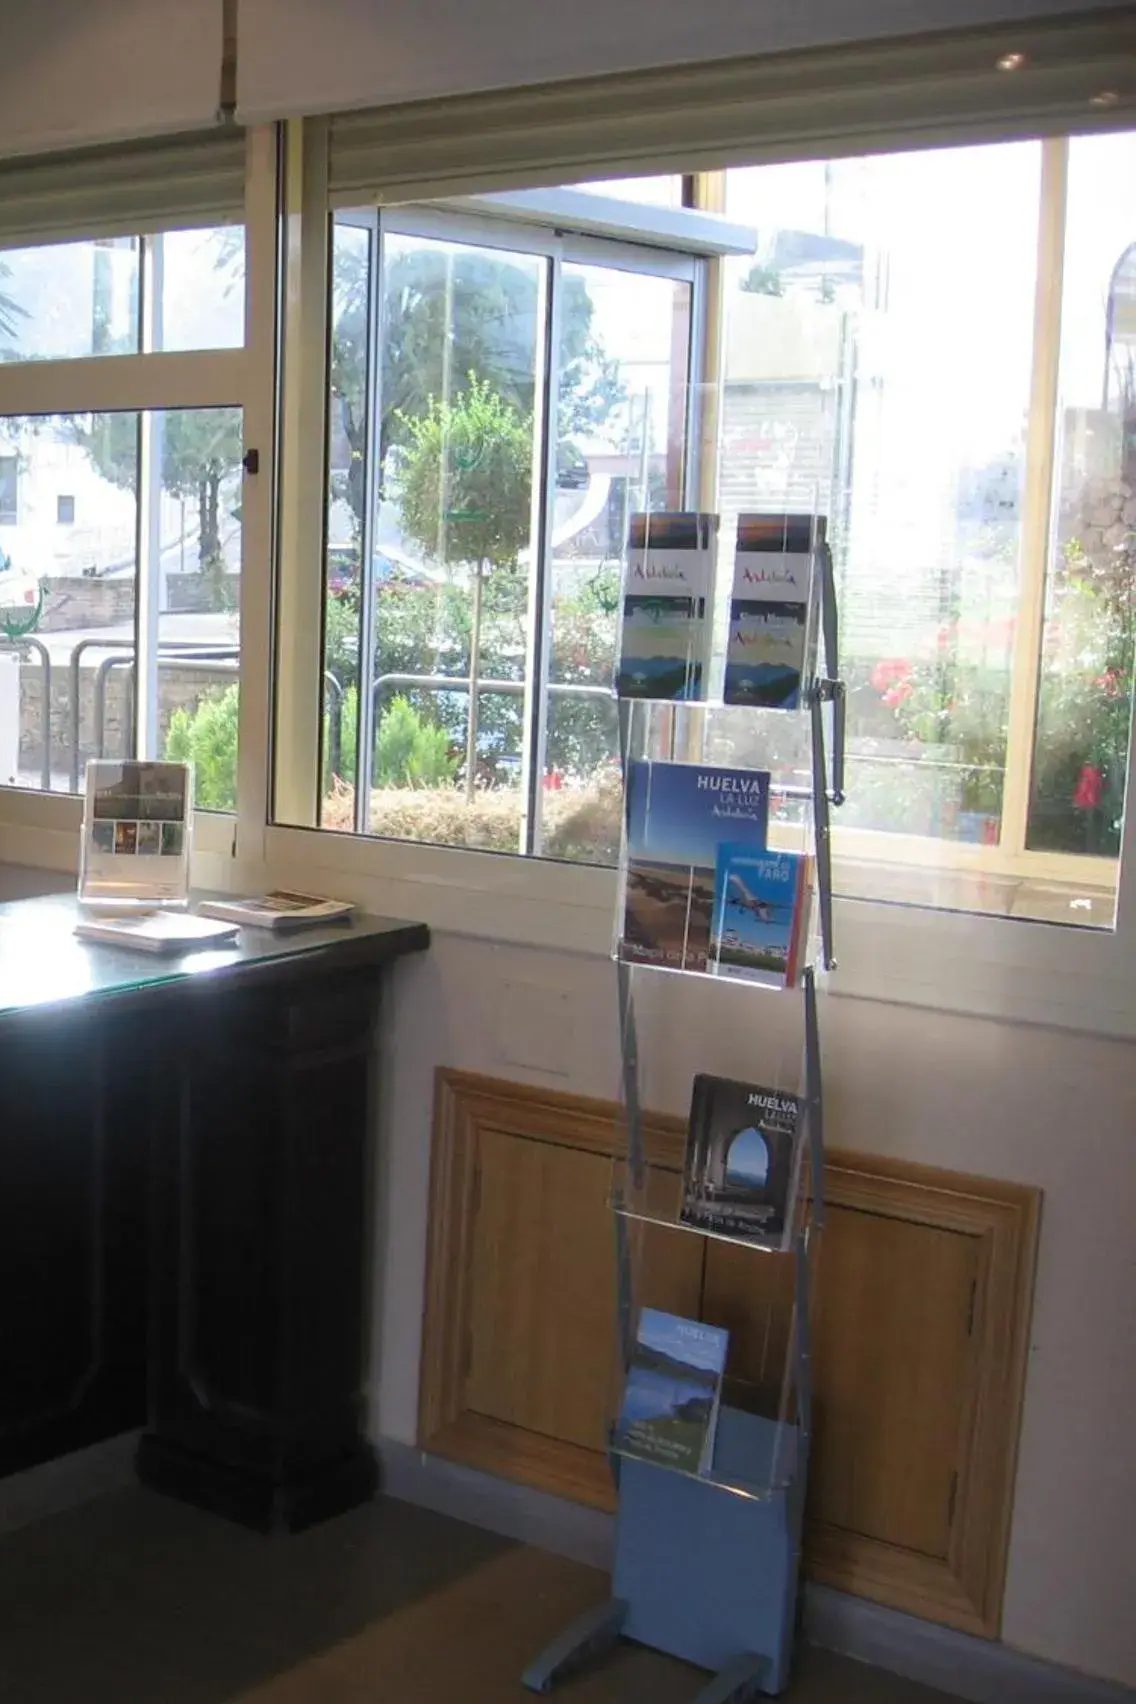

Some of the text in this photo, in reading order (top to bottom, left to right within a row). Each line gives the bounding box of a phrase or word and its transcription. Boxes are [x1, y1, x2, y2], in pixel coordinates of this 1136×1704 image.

[697, 774, 760, 794] HUELVA
[720, 792, 734, 804] LA
[747, 1092, 799, 1114] HUELVA
